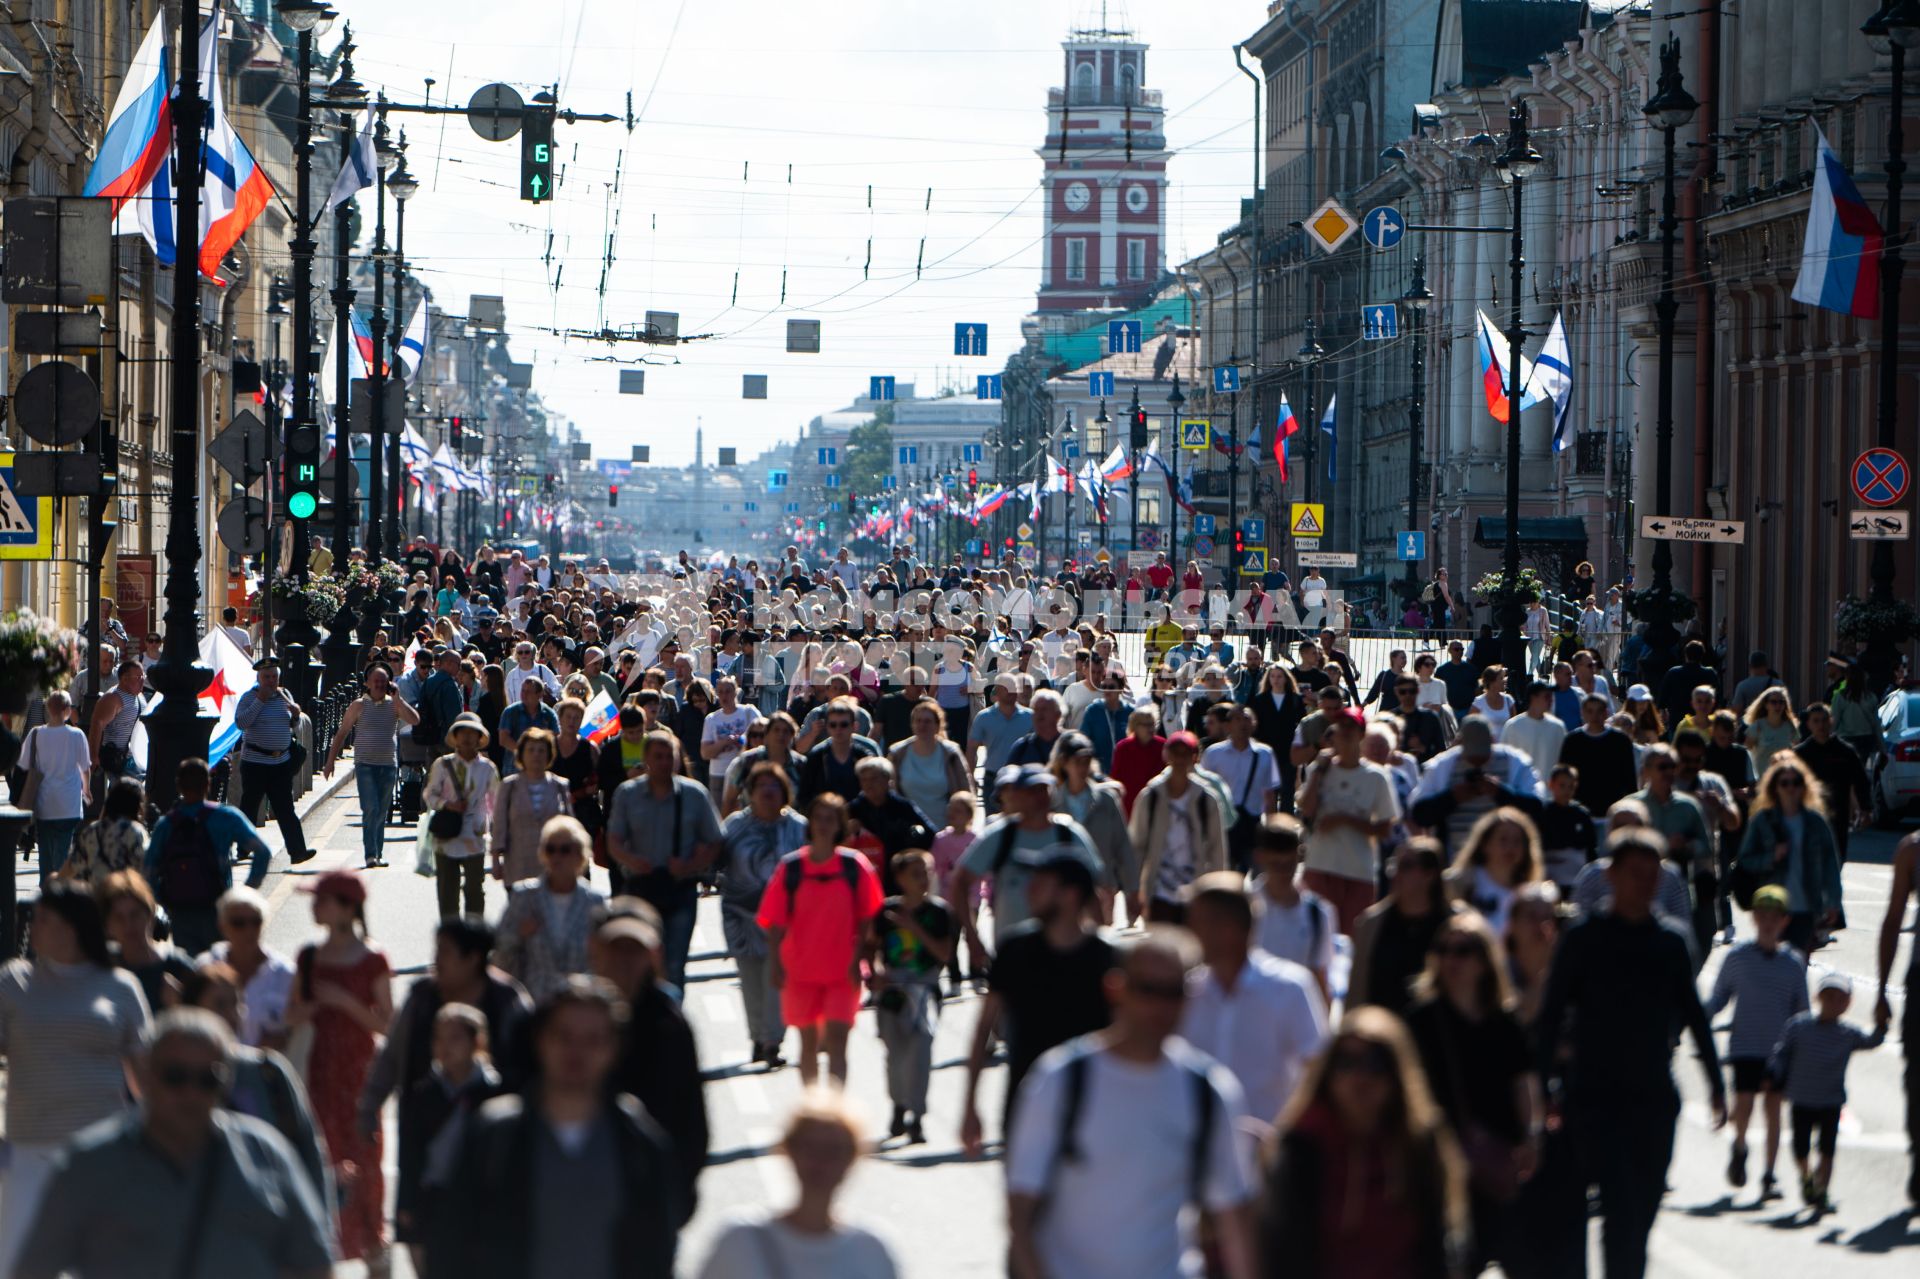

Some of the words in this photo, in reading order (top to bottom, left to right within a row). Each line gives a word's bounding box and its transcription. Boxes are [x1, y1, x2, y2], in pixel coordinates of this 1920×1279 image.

[300, 464, 314, 481] 14
[1693, 520, 1716, 530] реки
[1675, 529, 1711, 540] МОЙКИ
